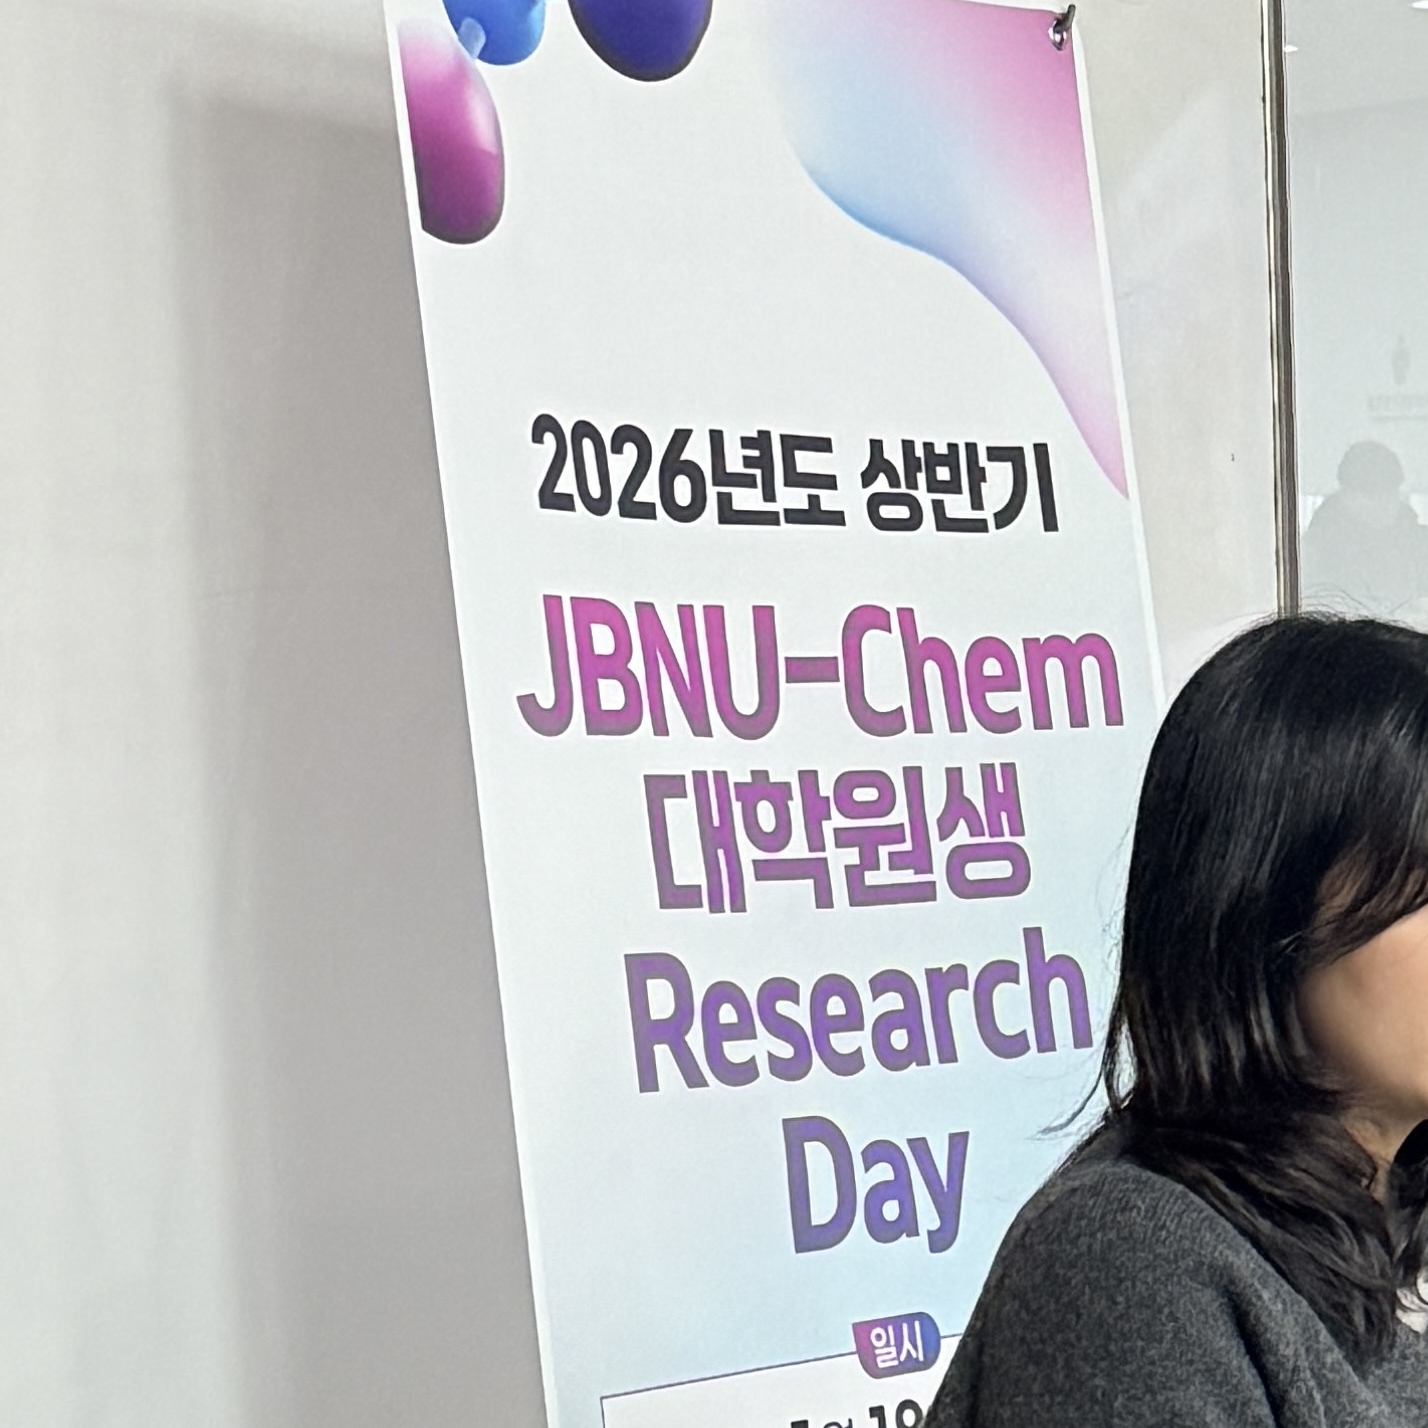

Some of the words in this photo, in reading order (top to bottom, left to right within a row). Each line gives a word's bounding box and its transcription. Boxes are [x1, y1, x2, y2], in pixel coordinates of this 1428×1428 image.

[531, 413, 847, 527] 2026년도
[860, 438, 1060, 533] 상반기
[516, 593, 1125, 741] JBNU-Chem
[643, 762, 1033, 915] 대학원생
[623, 926, 1095, 1095] Research
[782, 1115, 970, 1254] Day
[869, 1319, 924, 1369] 일시
